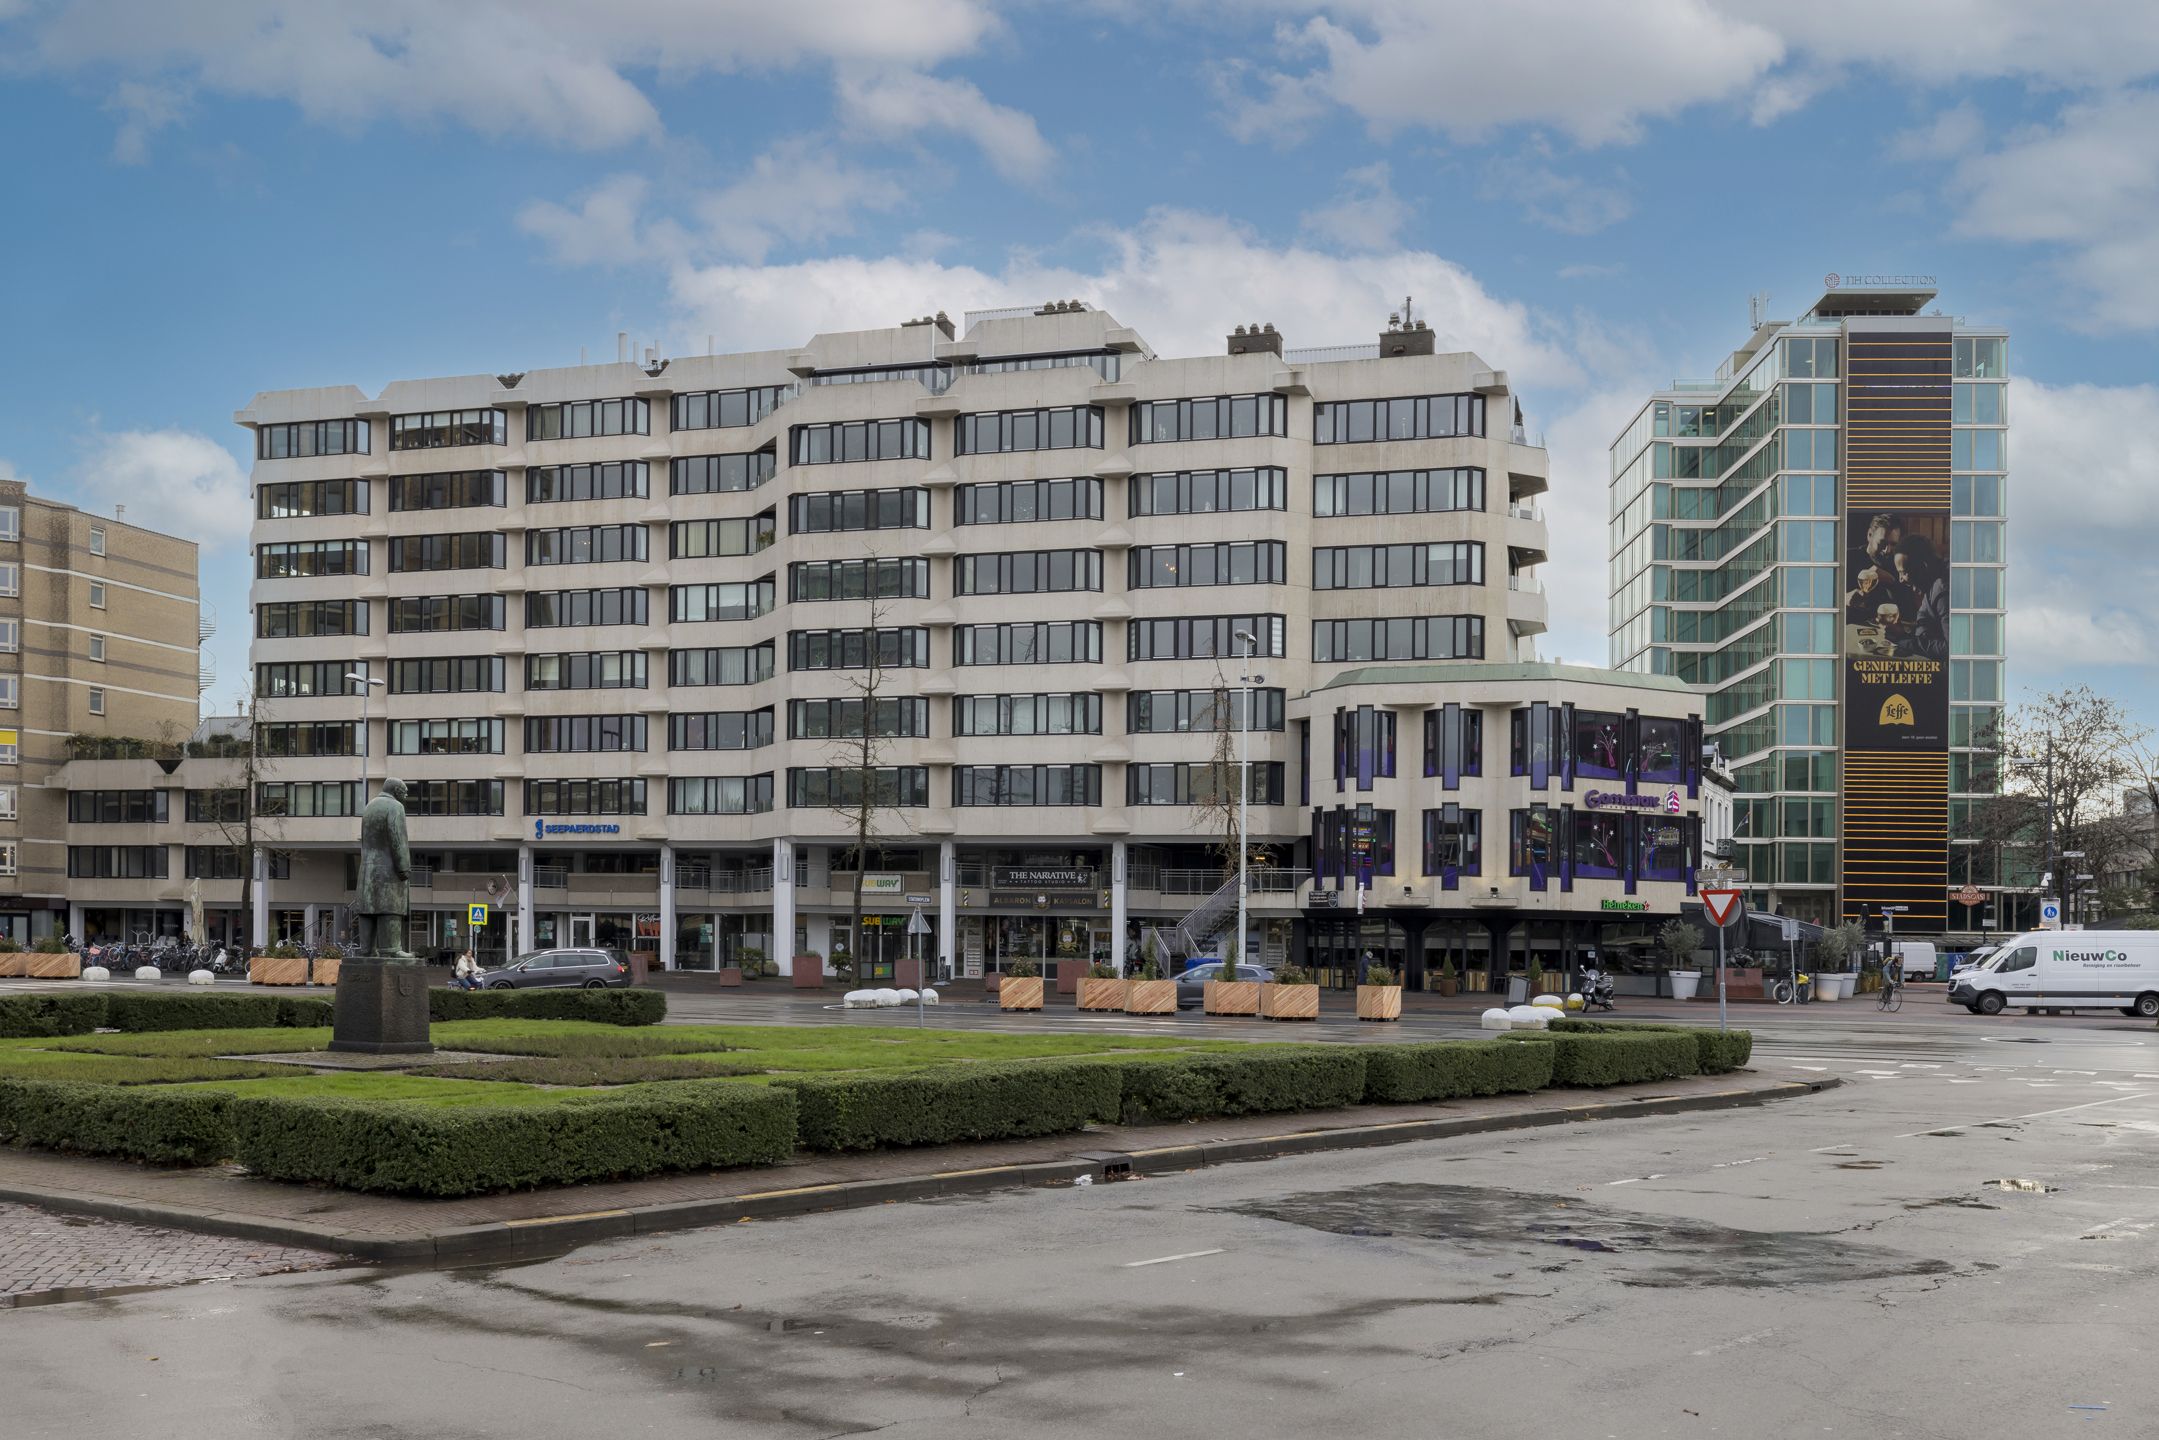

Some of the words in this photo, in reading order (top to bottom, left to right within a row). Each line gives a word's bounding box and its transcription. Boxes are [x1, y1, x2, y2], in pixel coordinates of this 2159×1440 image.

[1864, 275, 1937, 286] COLLECTION
[1853, 660, 1902, 672] GENIET
[1903, 661, 1941, 672] MEER
[1861, 673, 1889, 684] MET
[1891, 673, 1932, 684] LEFFE
[1886, 703, 1909, 720] Leffe
[1009, 871, 1028, 879] THE
[1029, 871, 1076, 880] NARRATIVE
[863, 879, 899, 888] UBWAY
[1601, 899, 1644, 910] Heineken
[863, 916, 907, 926] SUBWAY
[2053, 950, 2127, 961] NieuwCo
